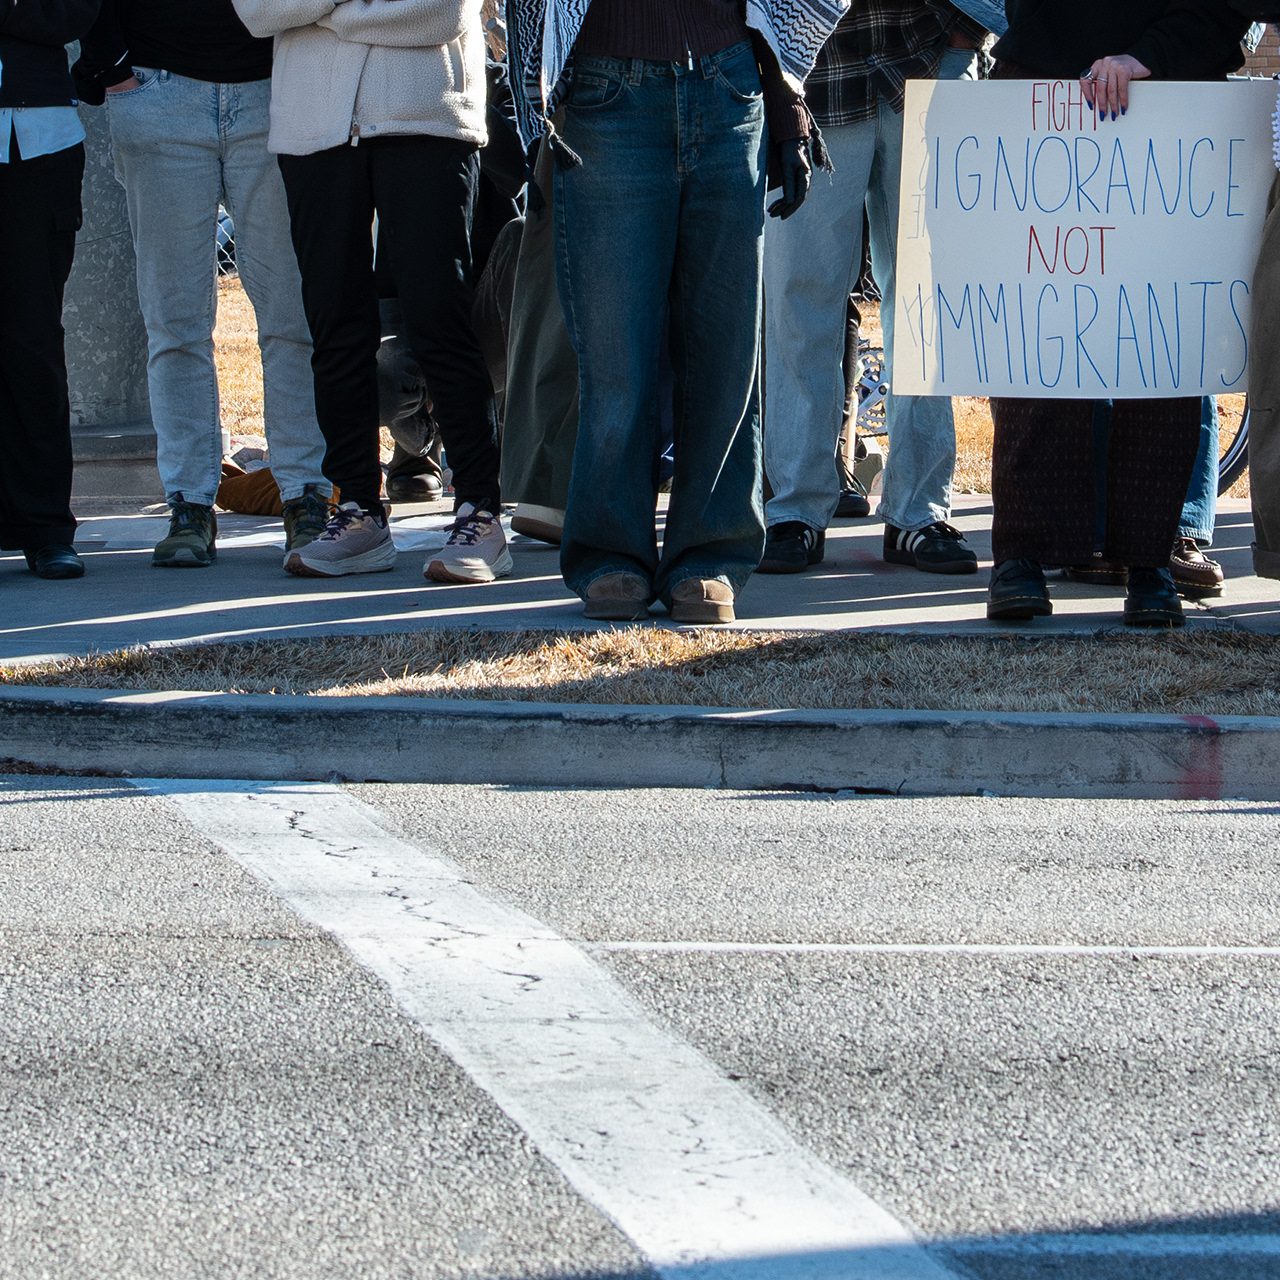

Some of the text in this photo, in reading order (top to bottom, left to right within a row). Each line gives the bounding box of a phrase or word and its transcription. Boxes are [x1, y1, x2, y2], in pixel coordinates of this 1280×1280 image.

[1032, 80, 1097, 131] FIGHT
[935, 136, 1246, 218] IGNORANCE
[1028, 225, 1116, 275] NOT
[918, 280, 1251, 389] IMMIGRANTS
